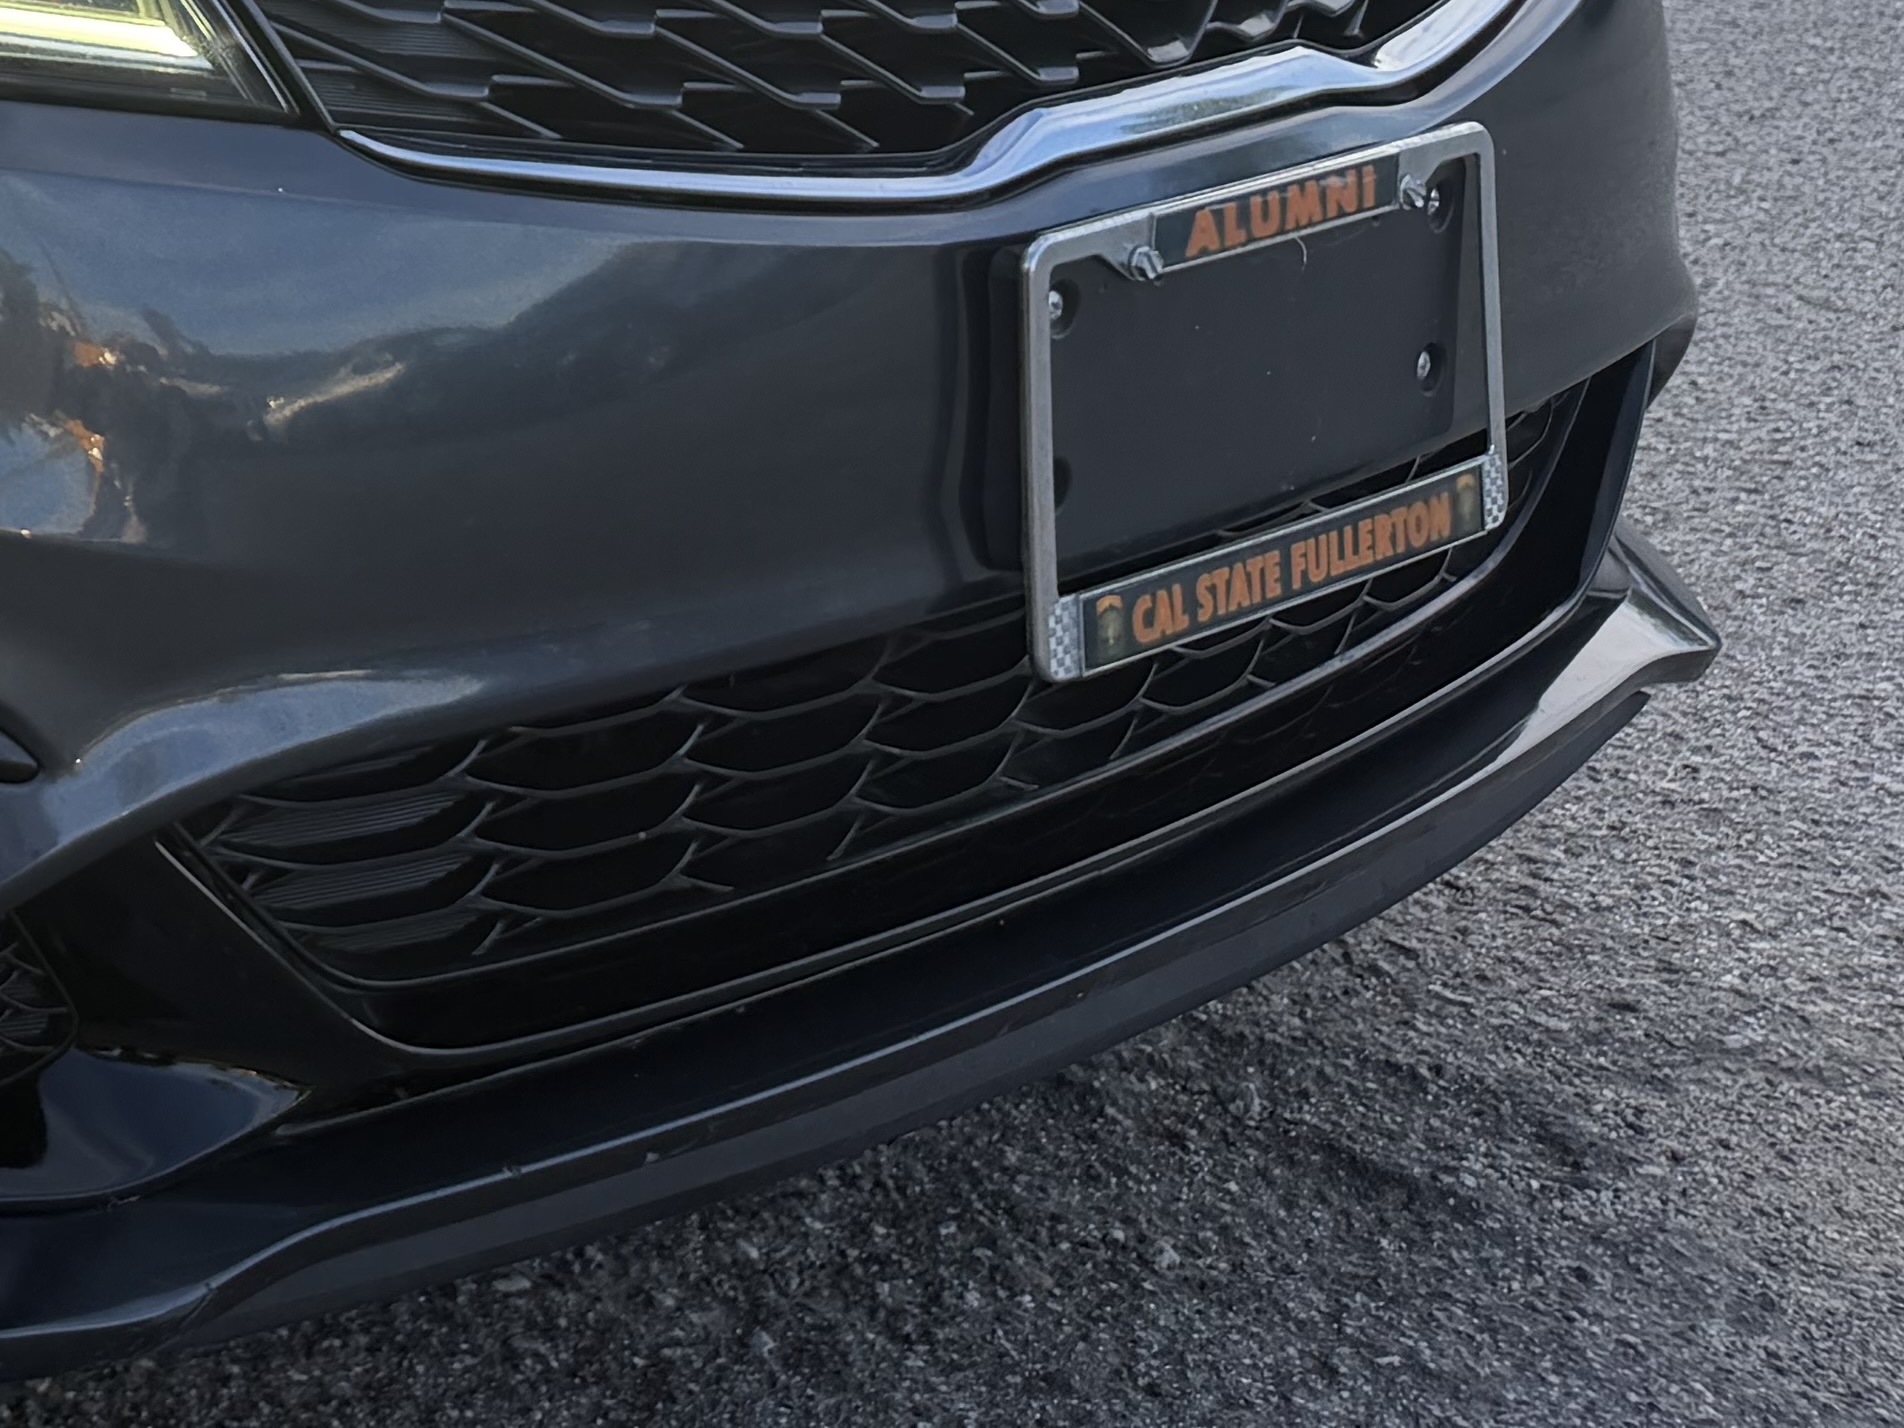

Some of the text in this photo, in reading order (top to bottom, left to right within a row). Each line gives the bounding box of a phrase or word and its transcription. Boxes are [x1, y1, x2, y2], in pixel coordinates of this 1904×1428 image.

[1184, 164, 1378, 258] ALUMNI
[1132, 491, 1452, 645] CAL STATE FULLERTON
